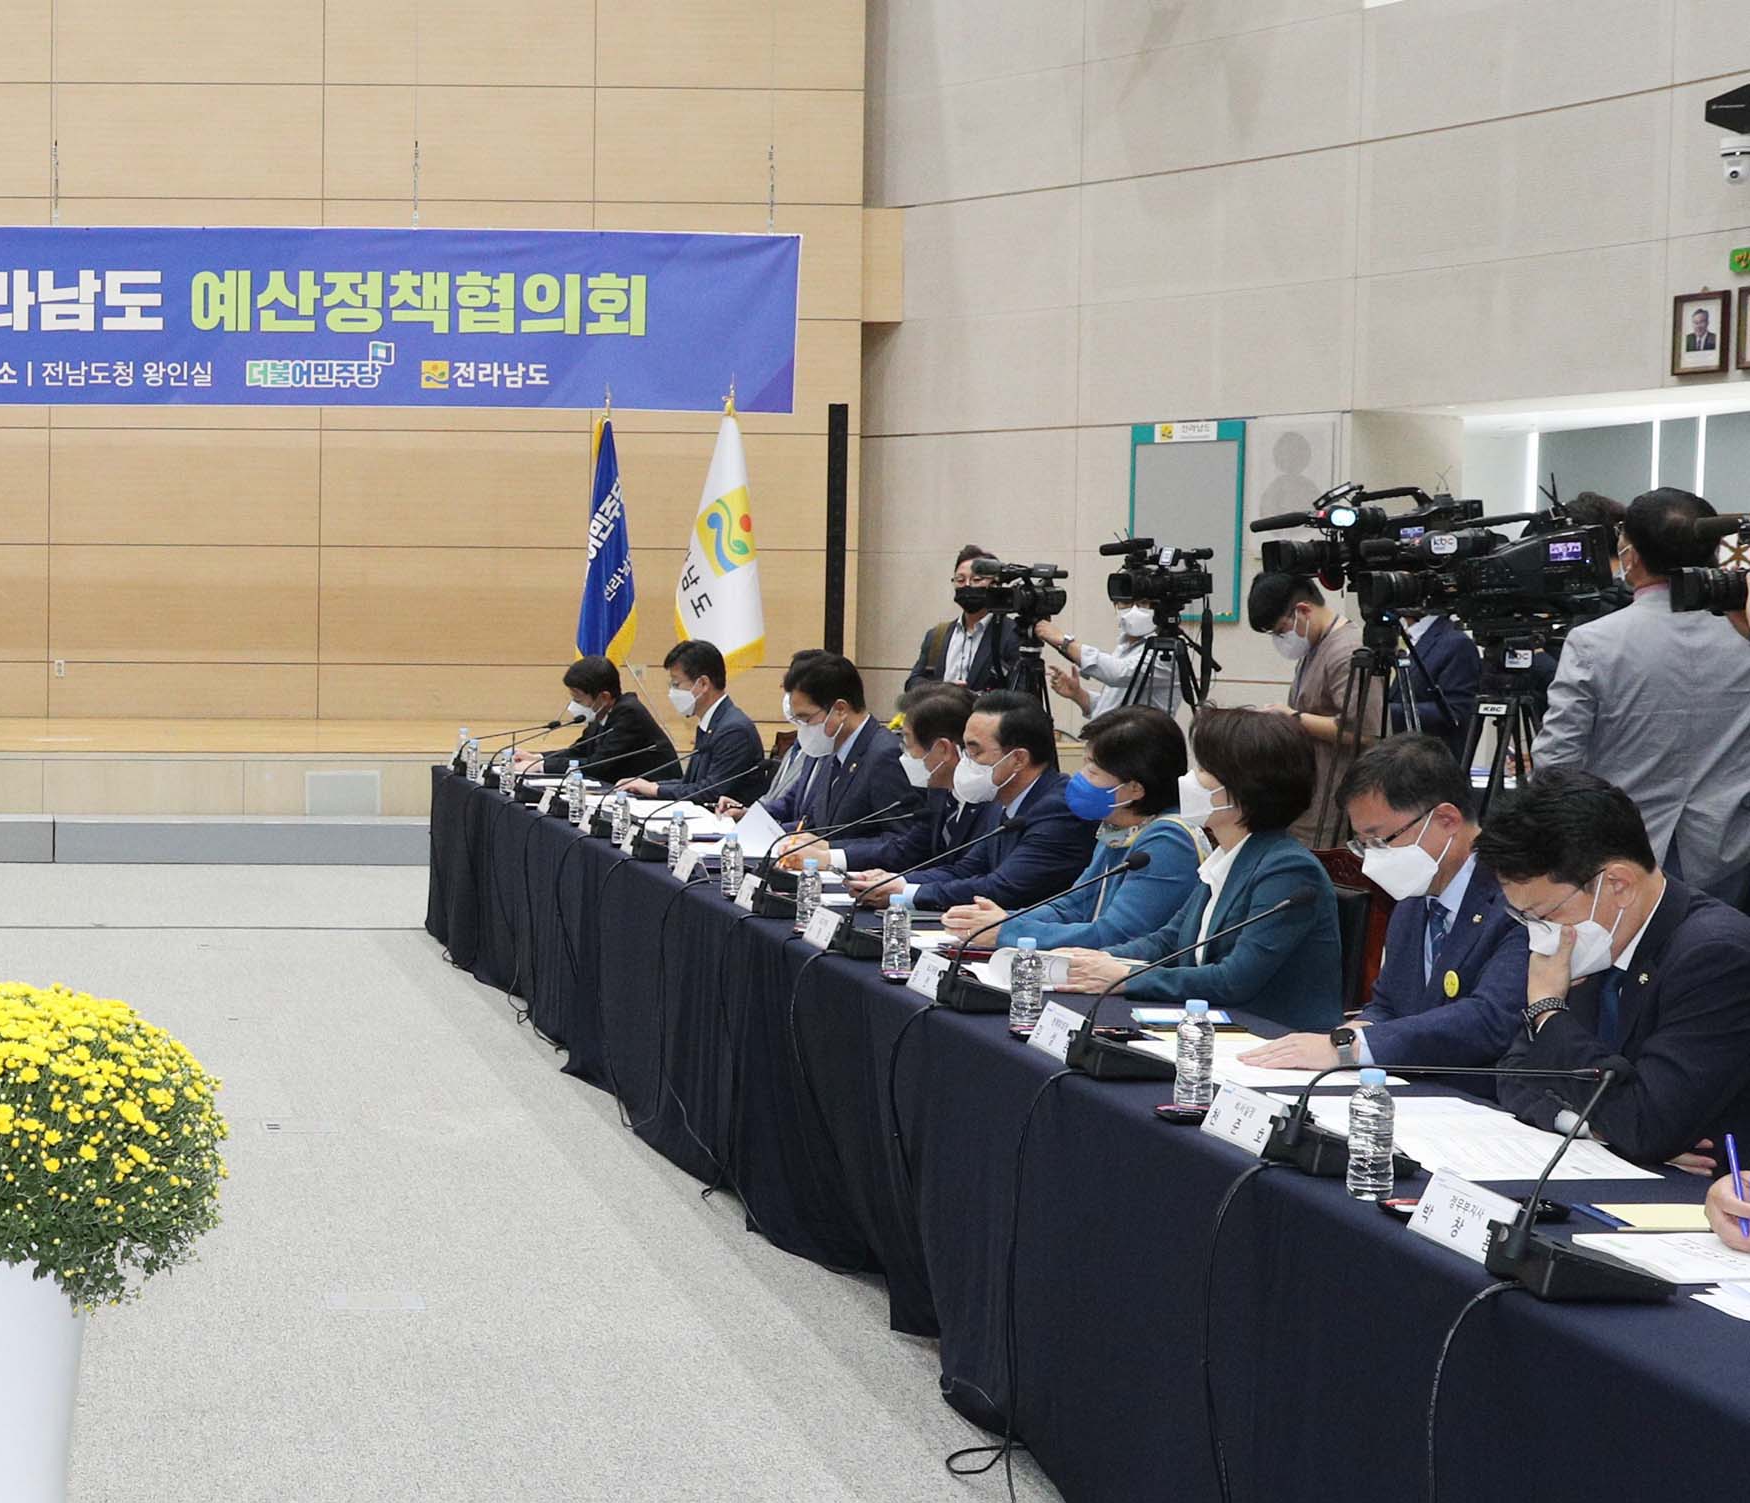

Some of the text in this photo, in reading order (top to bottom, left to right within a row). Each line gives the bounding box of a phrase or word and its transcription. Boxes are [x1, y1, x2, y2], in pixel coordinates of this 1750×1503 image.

[190, 269, 647, 337] 예산정책협의회
[41, 360, 134, 387] 전남도청
[141, 360, 213, 387] 왕인실
[246, 359, 381, 388] 더불어민주당
[451, 361, 551, 389] 전라남도
